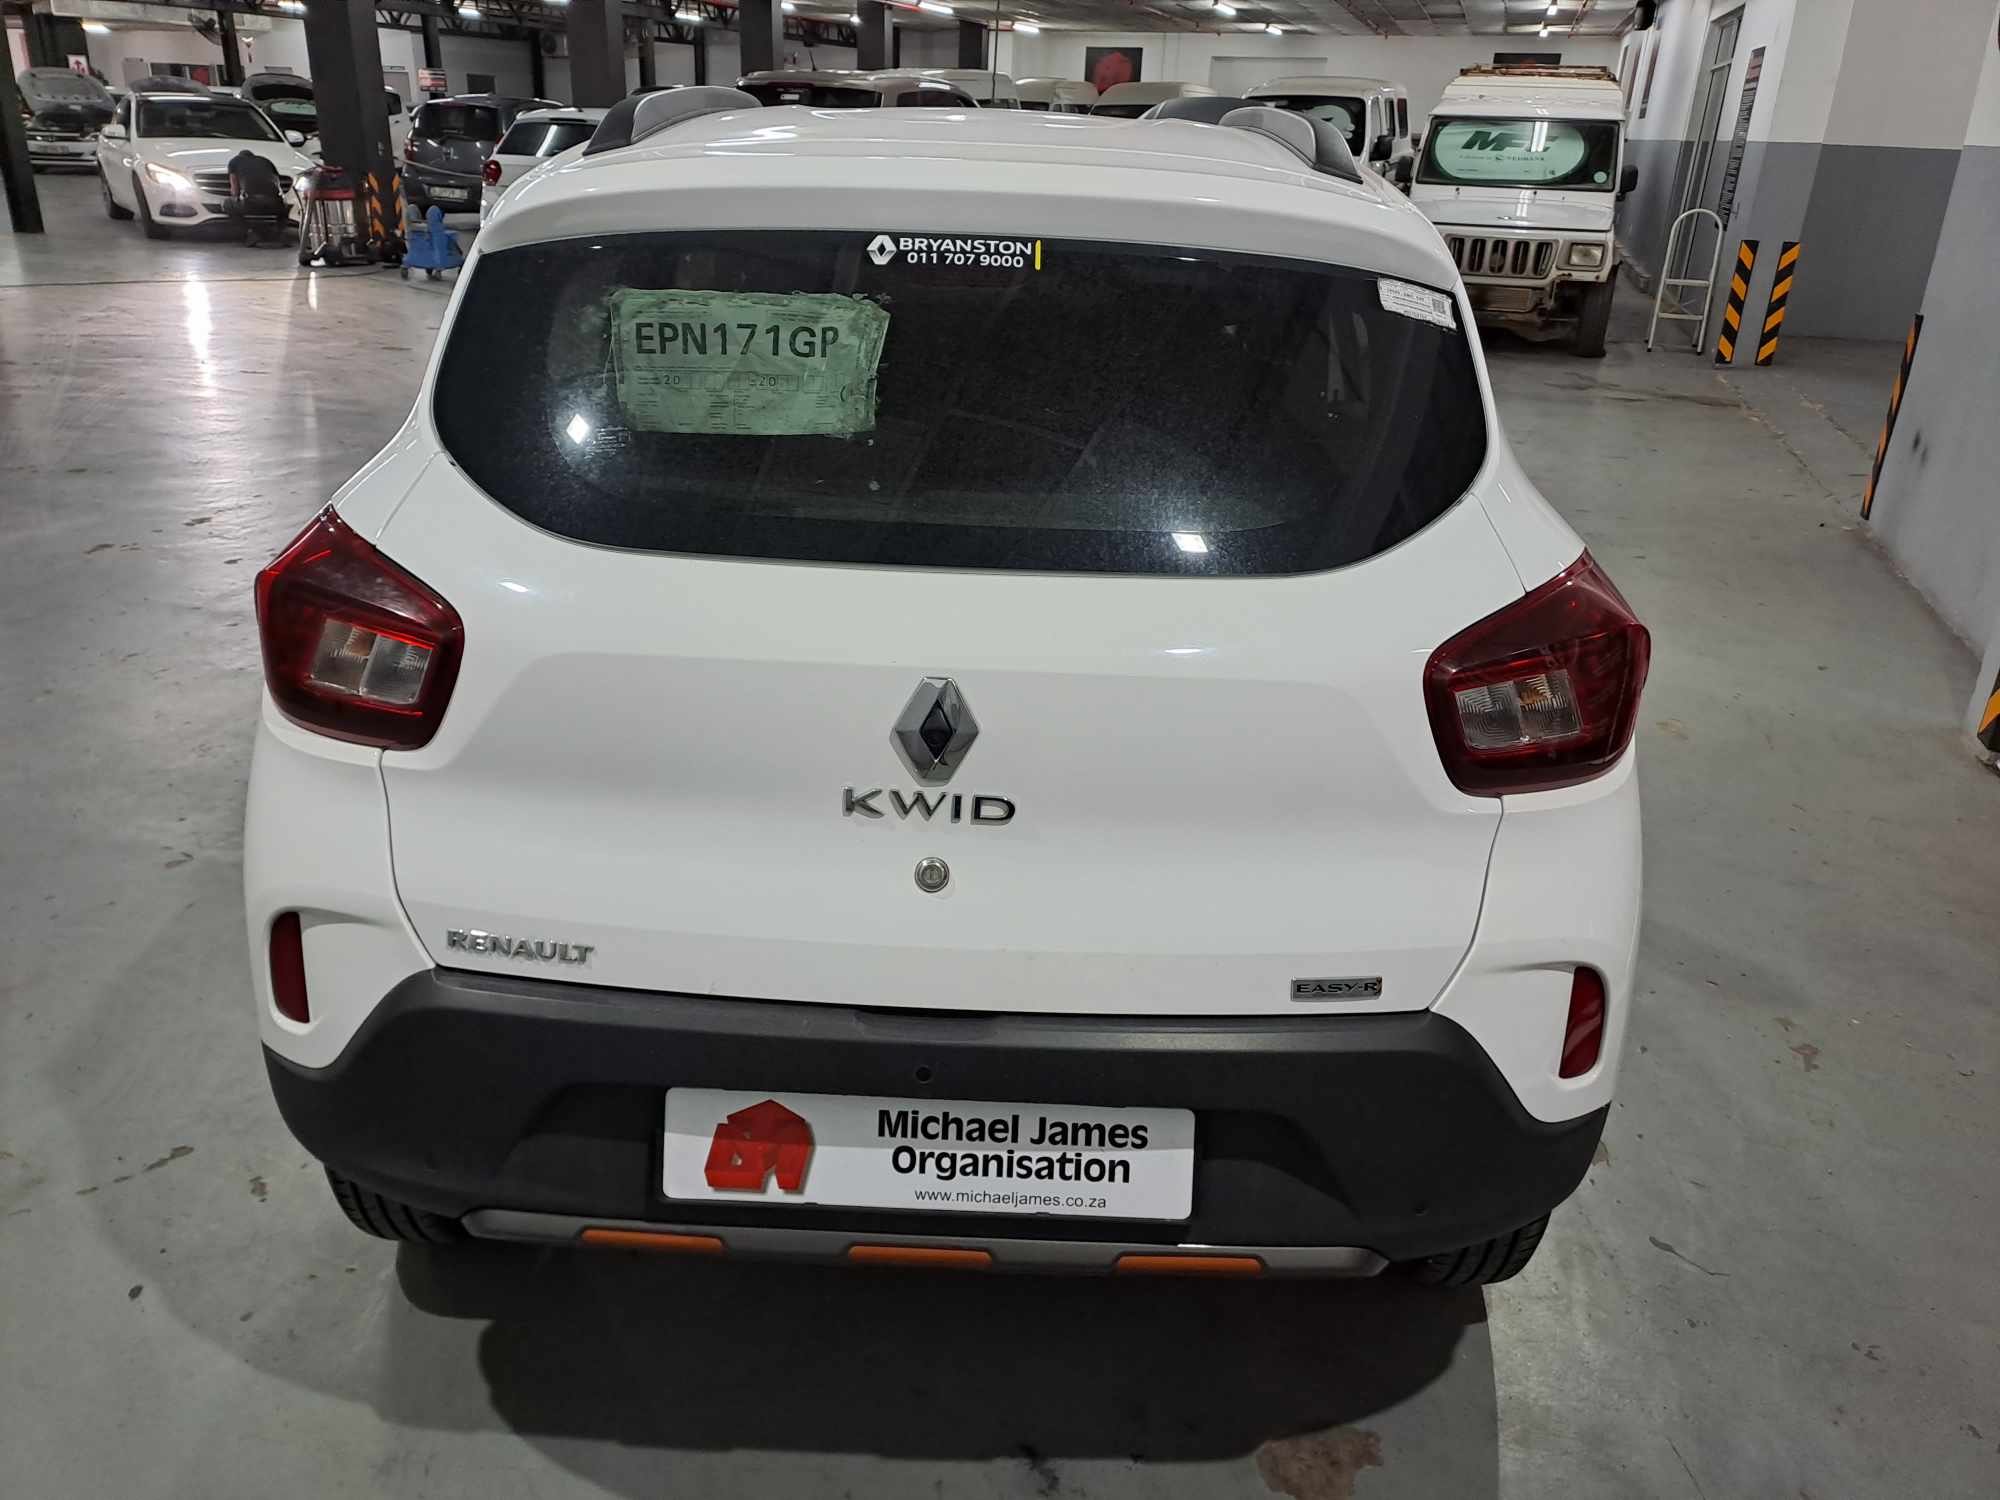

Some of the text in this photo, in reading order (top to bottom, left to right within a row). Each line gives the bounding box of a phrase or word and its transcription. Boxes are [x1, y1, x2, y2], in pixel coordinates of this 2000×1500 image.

[899, 237, 1032, 255] BRYANSTON
[907, 251, 1024, 268] 011 707 9000
[635, 322, 840, 359] EPN171GP
[841, 786, 1016, 826] KWID
[447, 928, 595, 964] RENAULT
[1296, 982, 1379, 994] EASY-R
[877, 1109, 1149, 1150] Michael James
[891, 1145, 1131, 1184] Organisation
[914, 1188, 1107, 1209] www.michaeljames.co.za
